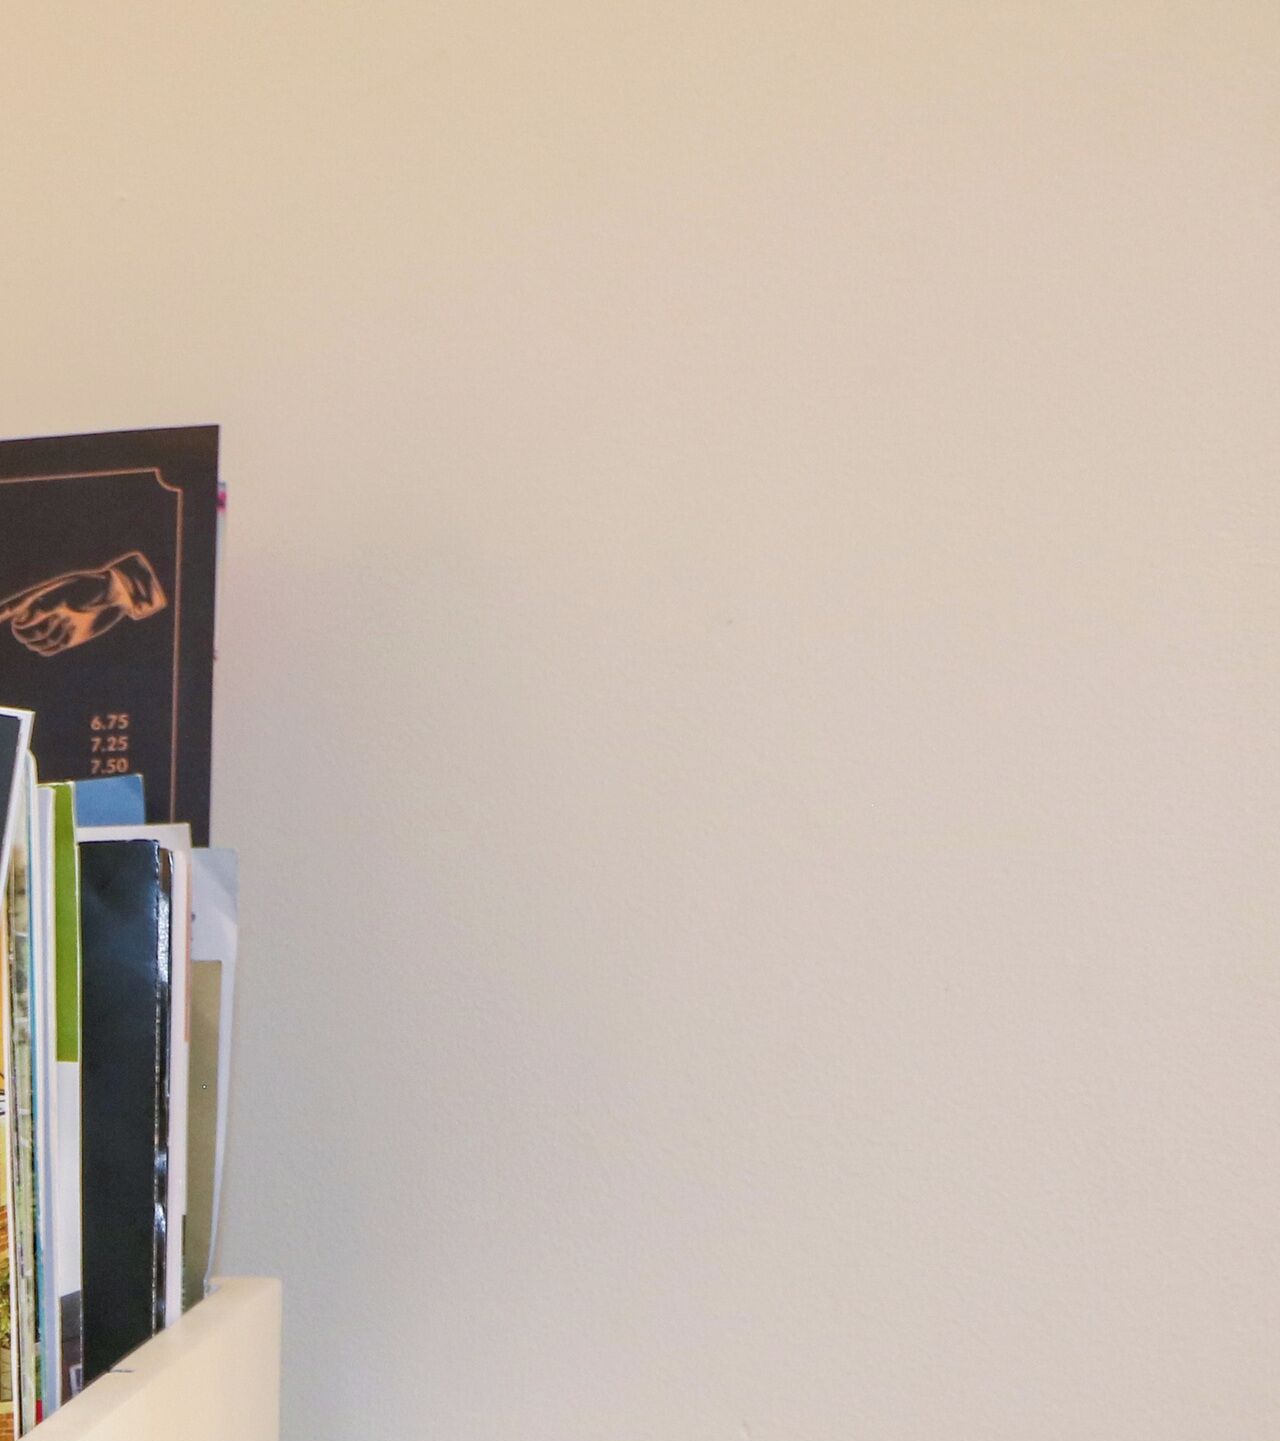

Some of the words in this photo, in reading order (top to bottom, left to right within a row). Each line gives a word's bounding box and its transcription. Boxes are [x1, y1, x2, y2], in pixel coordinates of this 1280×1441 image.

[91, 714, 129, 731] 6.75
[91, 736, 129, 752] 7.25
[91, 758, 129, 774] 7.50
